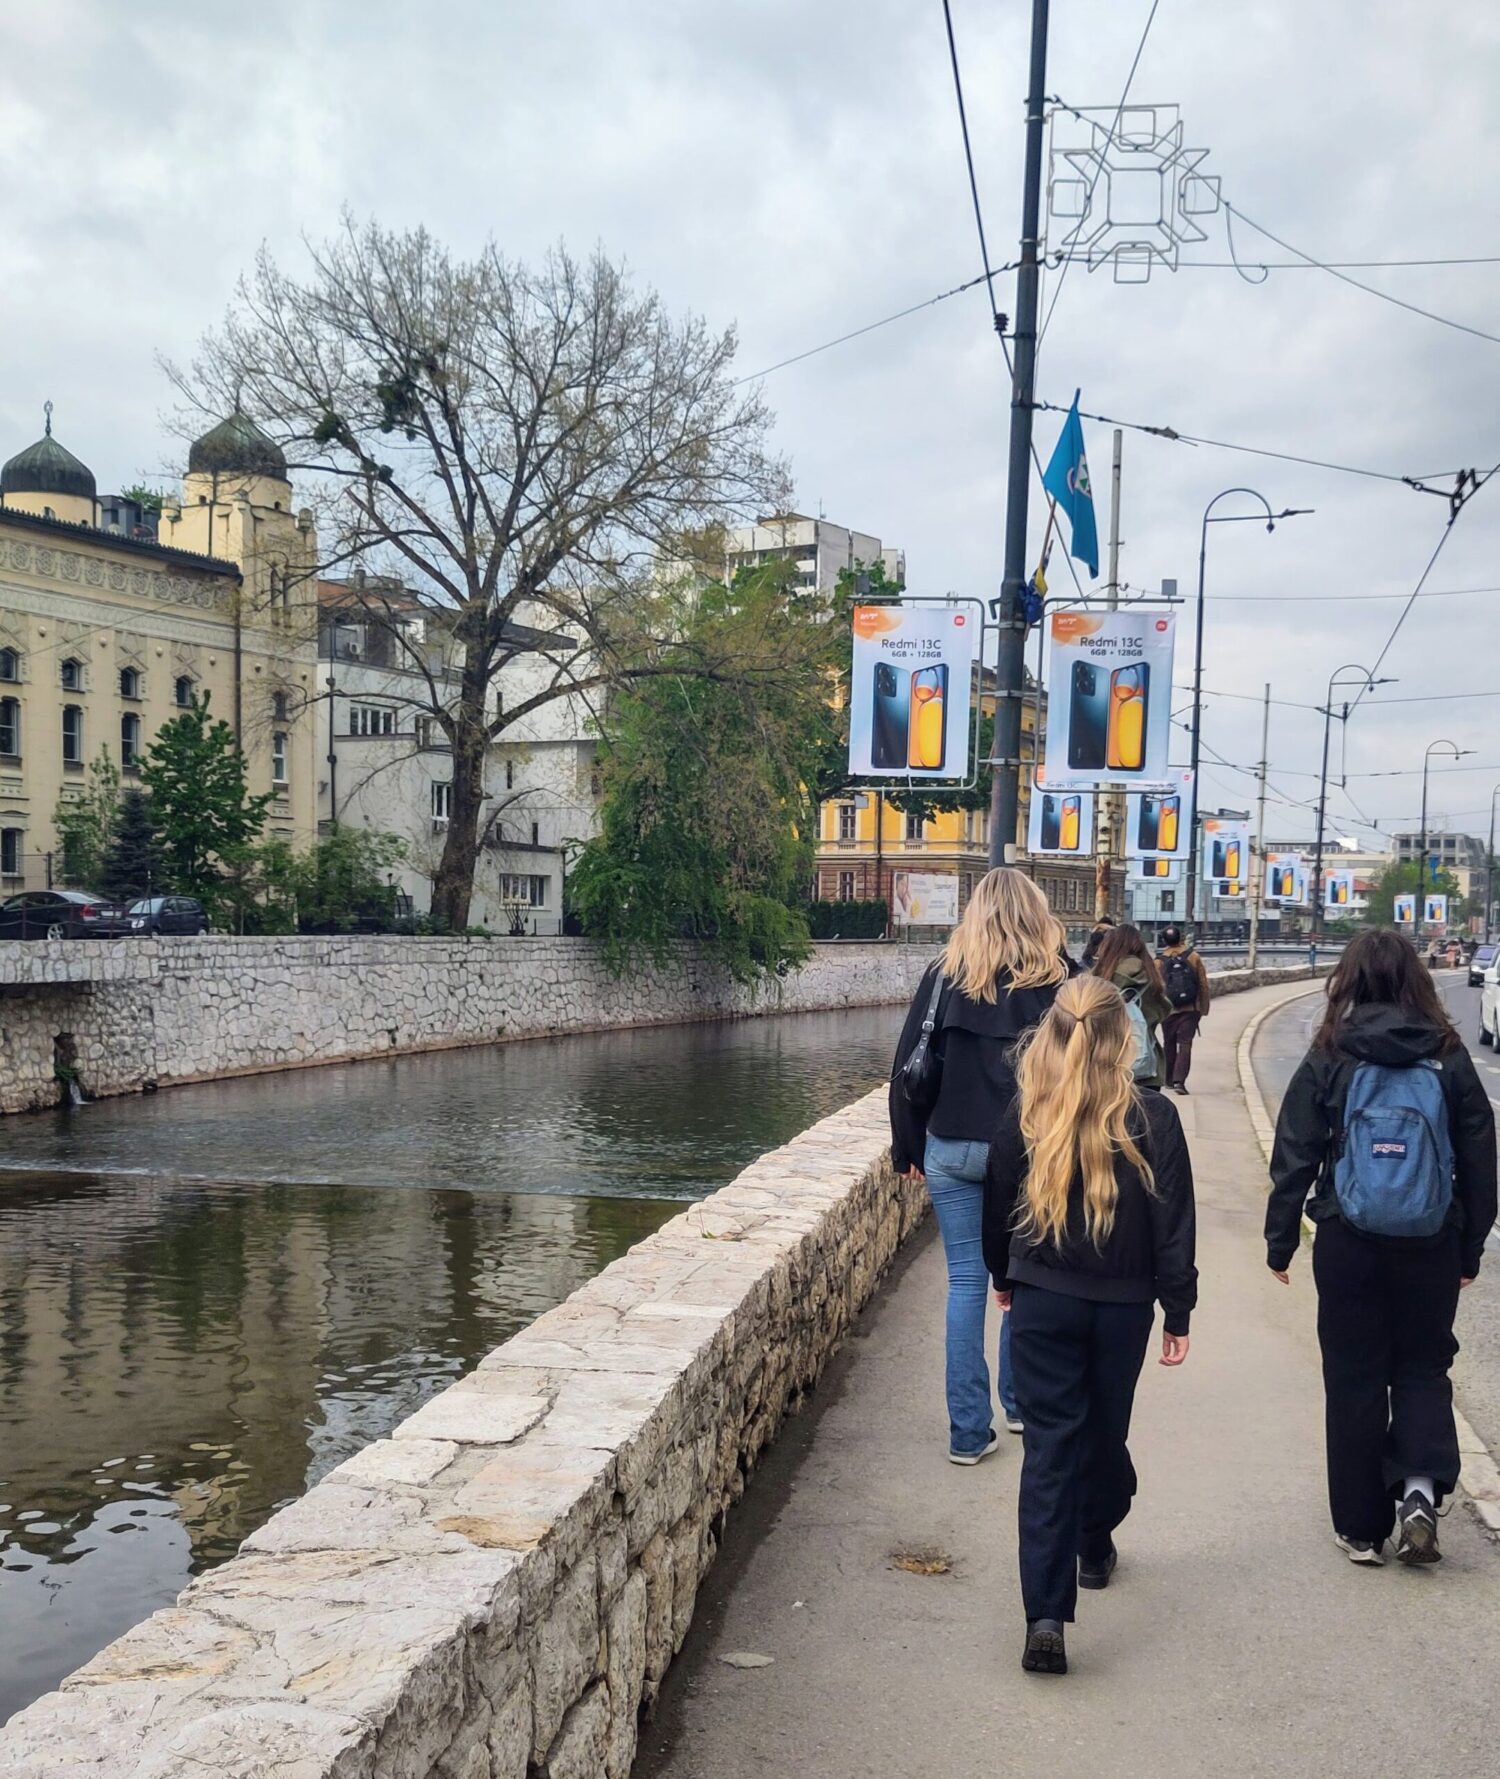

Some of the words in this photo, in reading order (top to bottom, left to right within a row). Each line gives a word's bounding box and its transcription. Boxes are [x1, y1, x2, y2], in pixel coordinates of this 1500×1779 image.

[881, 639, 917, 649] Redmi
[922, 640, 941, 649] 13C
[1080, 637, 1117, 647] Redmi
[1122, 637, 1143, 648] 13C
